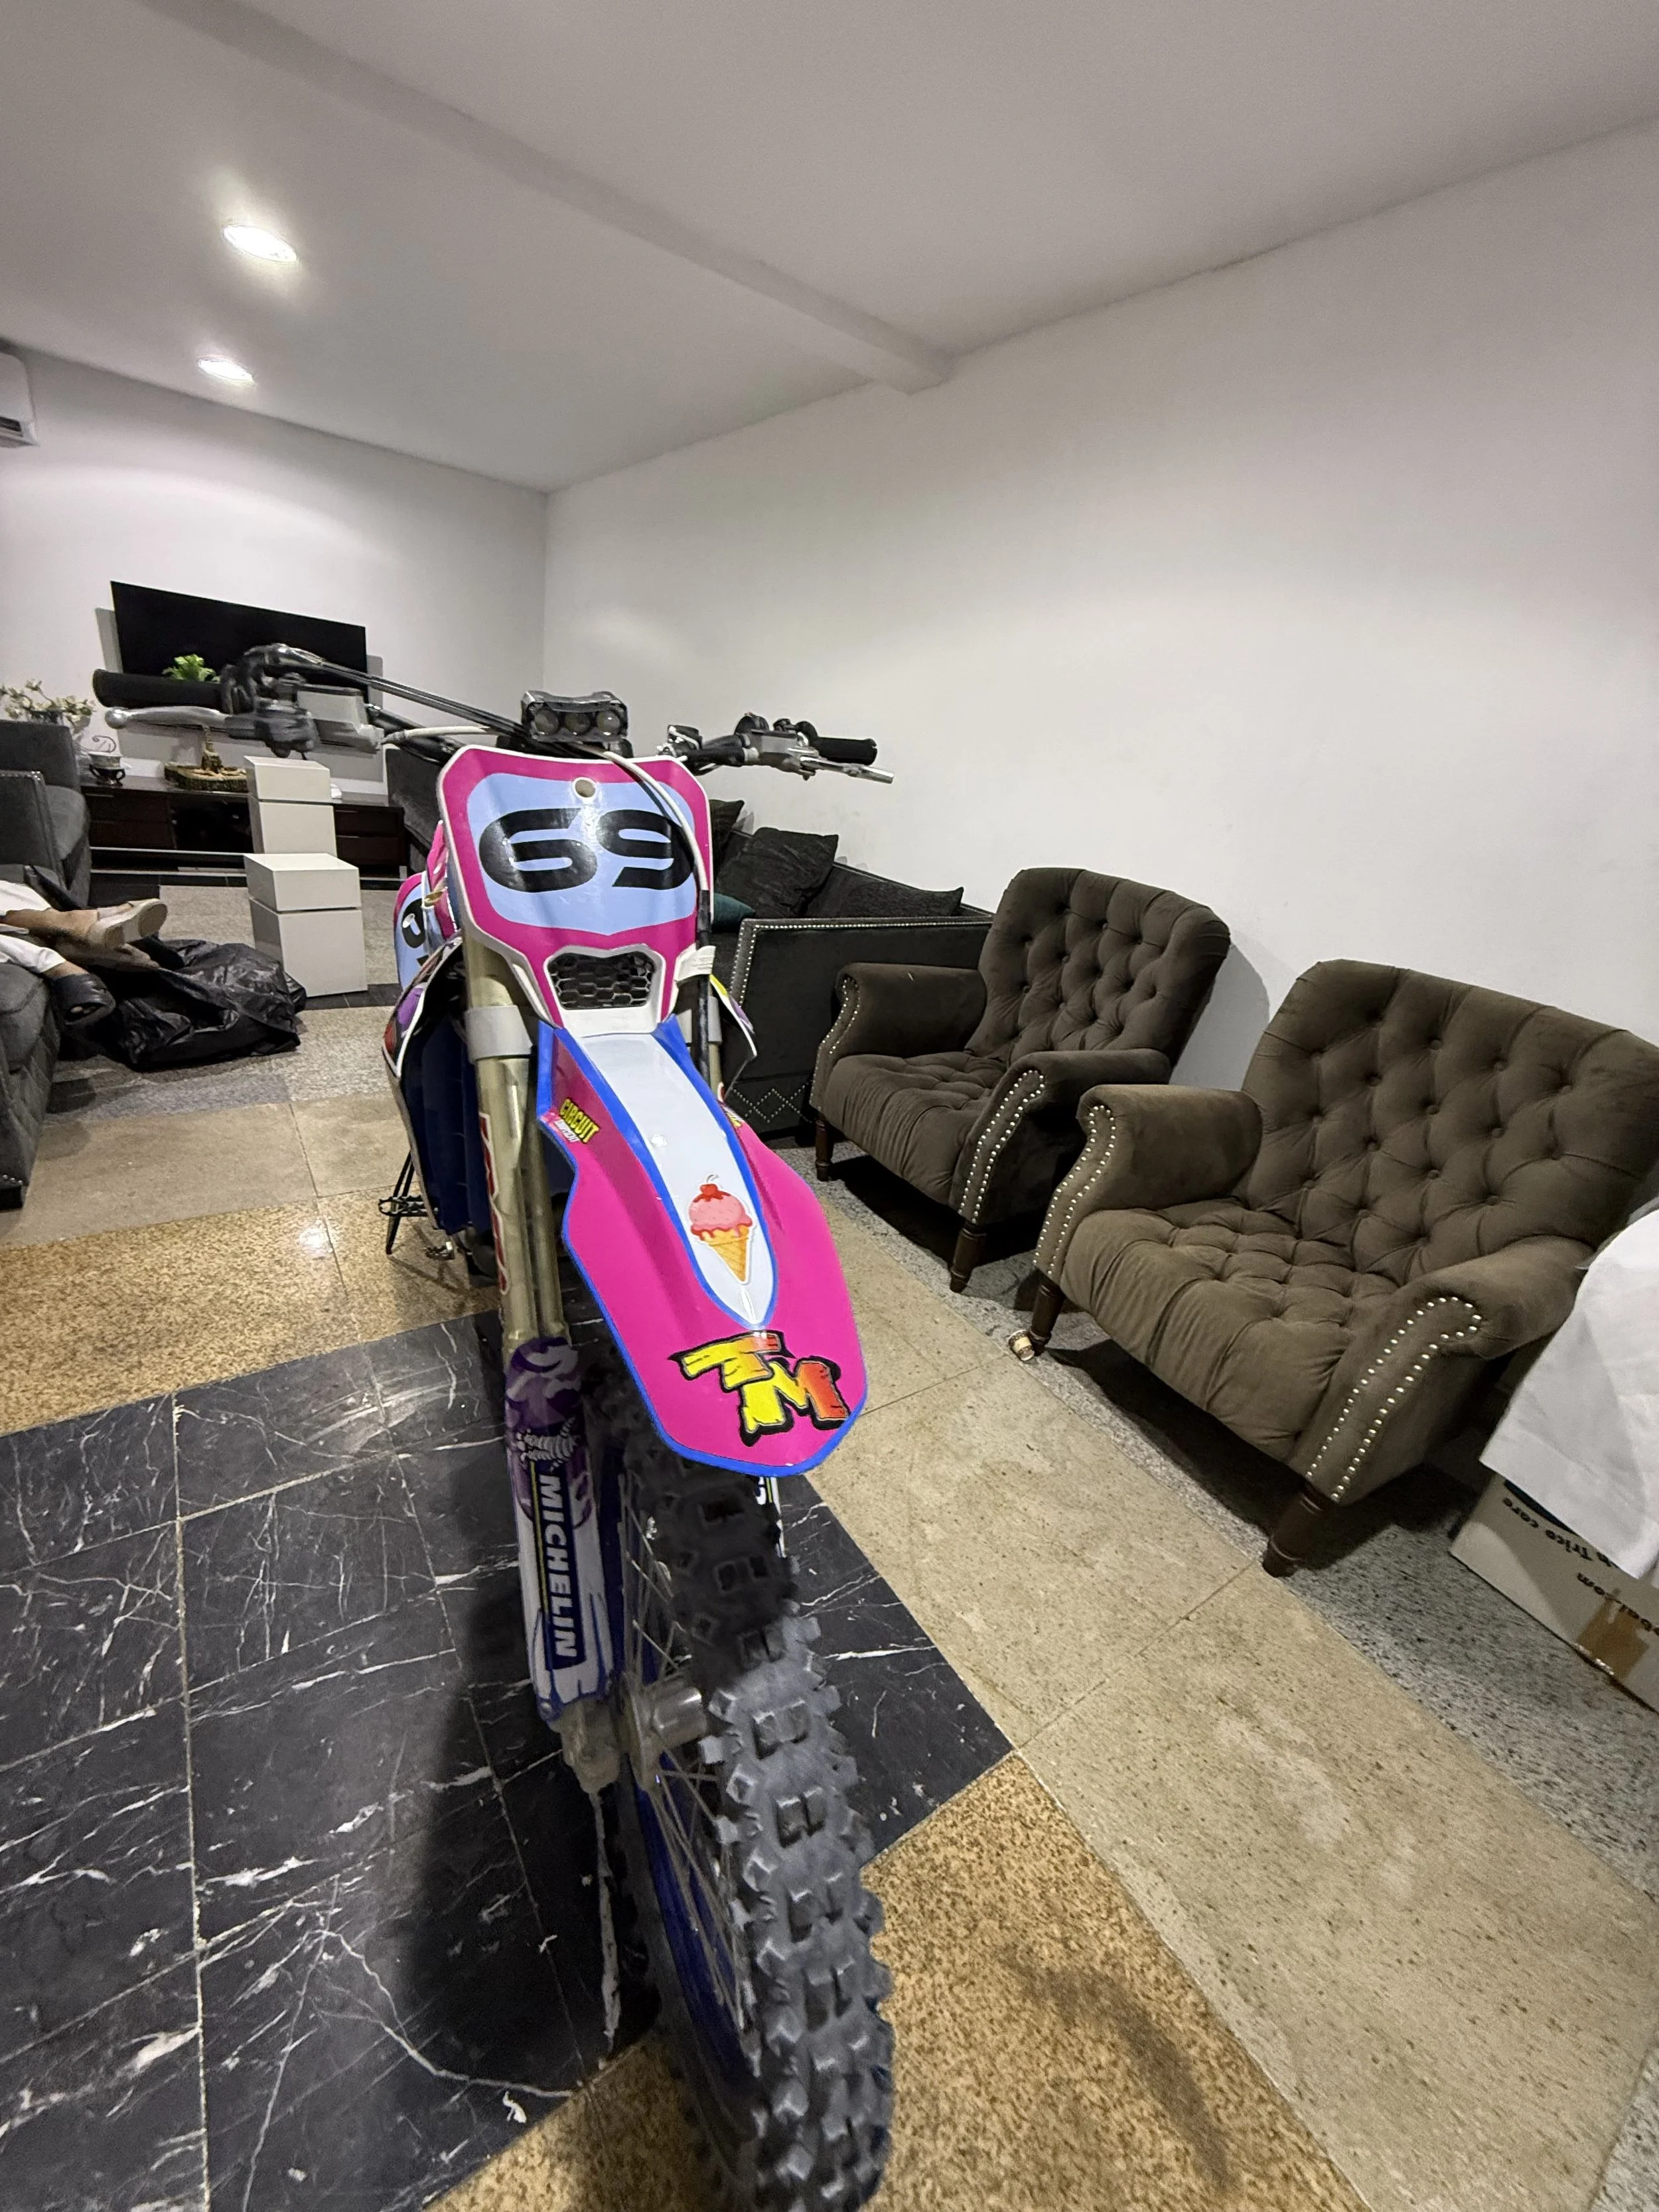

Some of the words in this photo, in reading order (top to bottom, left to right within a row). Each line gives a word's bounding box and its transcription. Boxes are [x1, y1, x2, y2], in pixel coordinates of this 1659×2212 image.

[478, 807, 695, 893] 69
[559, 1097, 601, 1144] CIRCUIT
[668, 1329, 851, 1447] TM
[1502, 1497, 1540, 1529] care
[538, 1473, 577, 1658] MICHELIN
